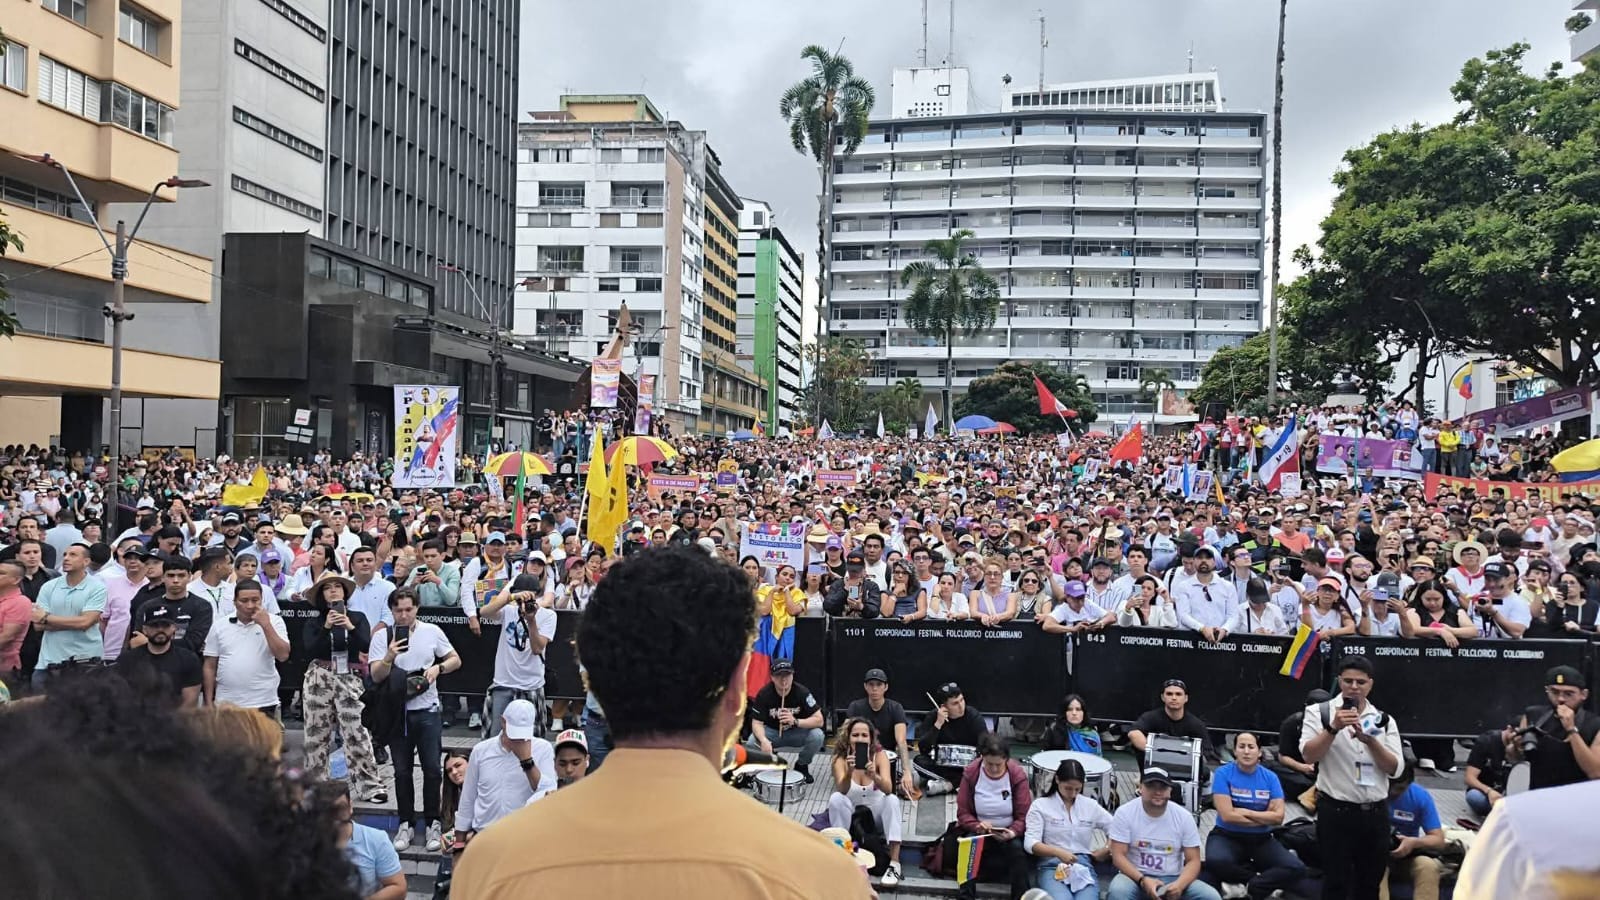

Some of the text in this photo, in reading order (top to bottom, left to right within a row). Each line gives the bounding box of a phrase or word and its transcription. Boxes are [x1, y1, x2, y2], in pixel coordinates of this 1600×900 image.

[677, 480, 695, 488] MARZO
[845, 628, 1023, 639] 1101 CORPORACION FESTIVAL FOLCLORICO COLOMBIANO
[1087, 633, 1106, 643] 643
[1120, 635, 1163, 646] CORPORACION
[1166, 638, 1194, 649] FESTIVAL
[1242, 643, 1283, 655] COLOMBIANO
[1343, 646, 1544, 659] 1355 CORPORACION FESTIVAL FOLCLORICO COLOMBIANO
[1140, 852, 1164, 870] 102
